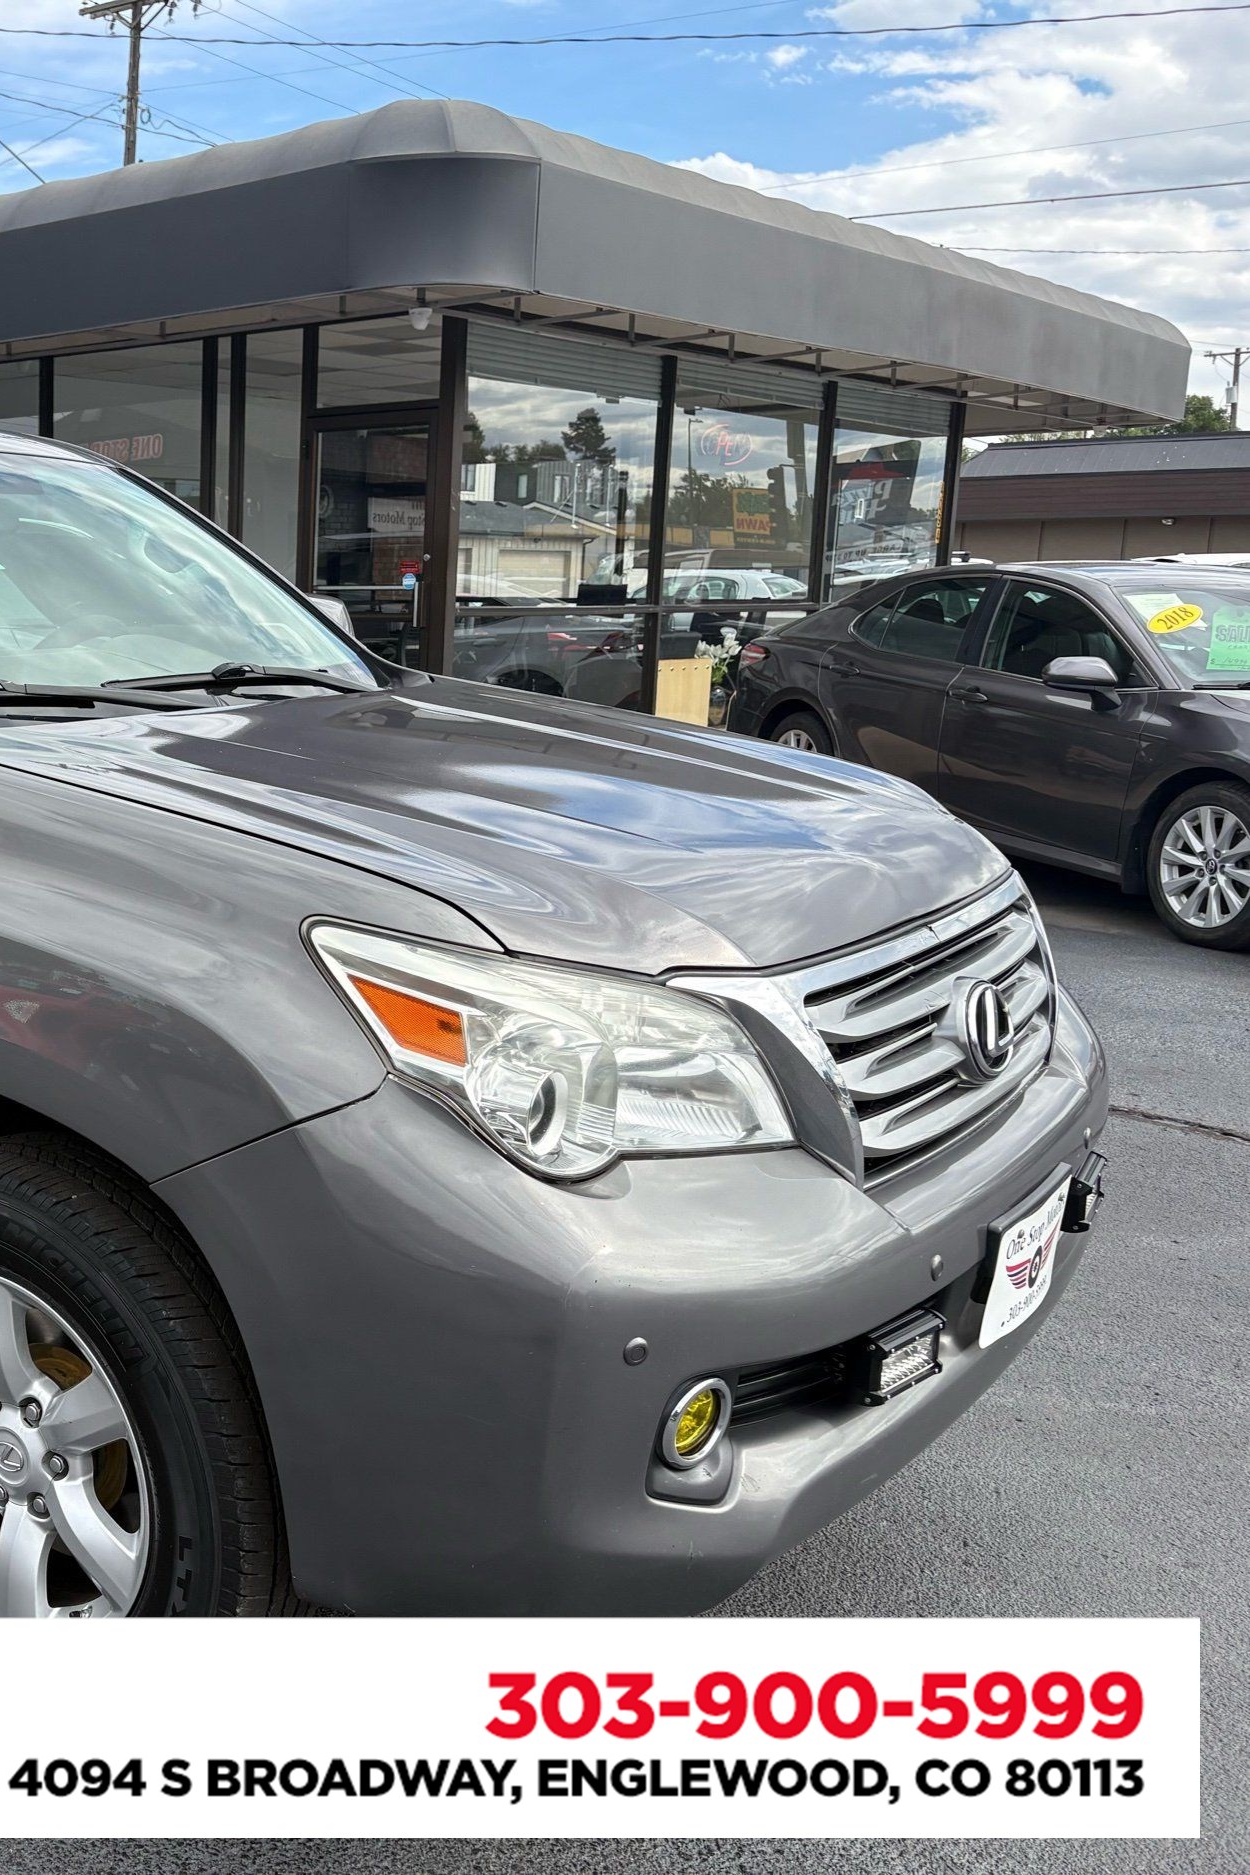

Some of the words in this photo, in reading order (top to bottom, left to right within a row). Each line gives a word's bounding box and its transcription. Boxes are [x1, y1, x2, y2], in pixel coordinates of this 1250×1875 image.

[1157, 607, 1194, 630] 2018
[1006, 1236, 1026, 1260] One
[1026, 1221, 1046, 1246] Stop
